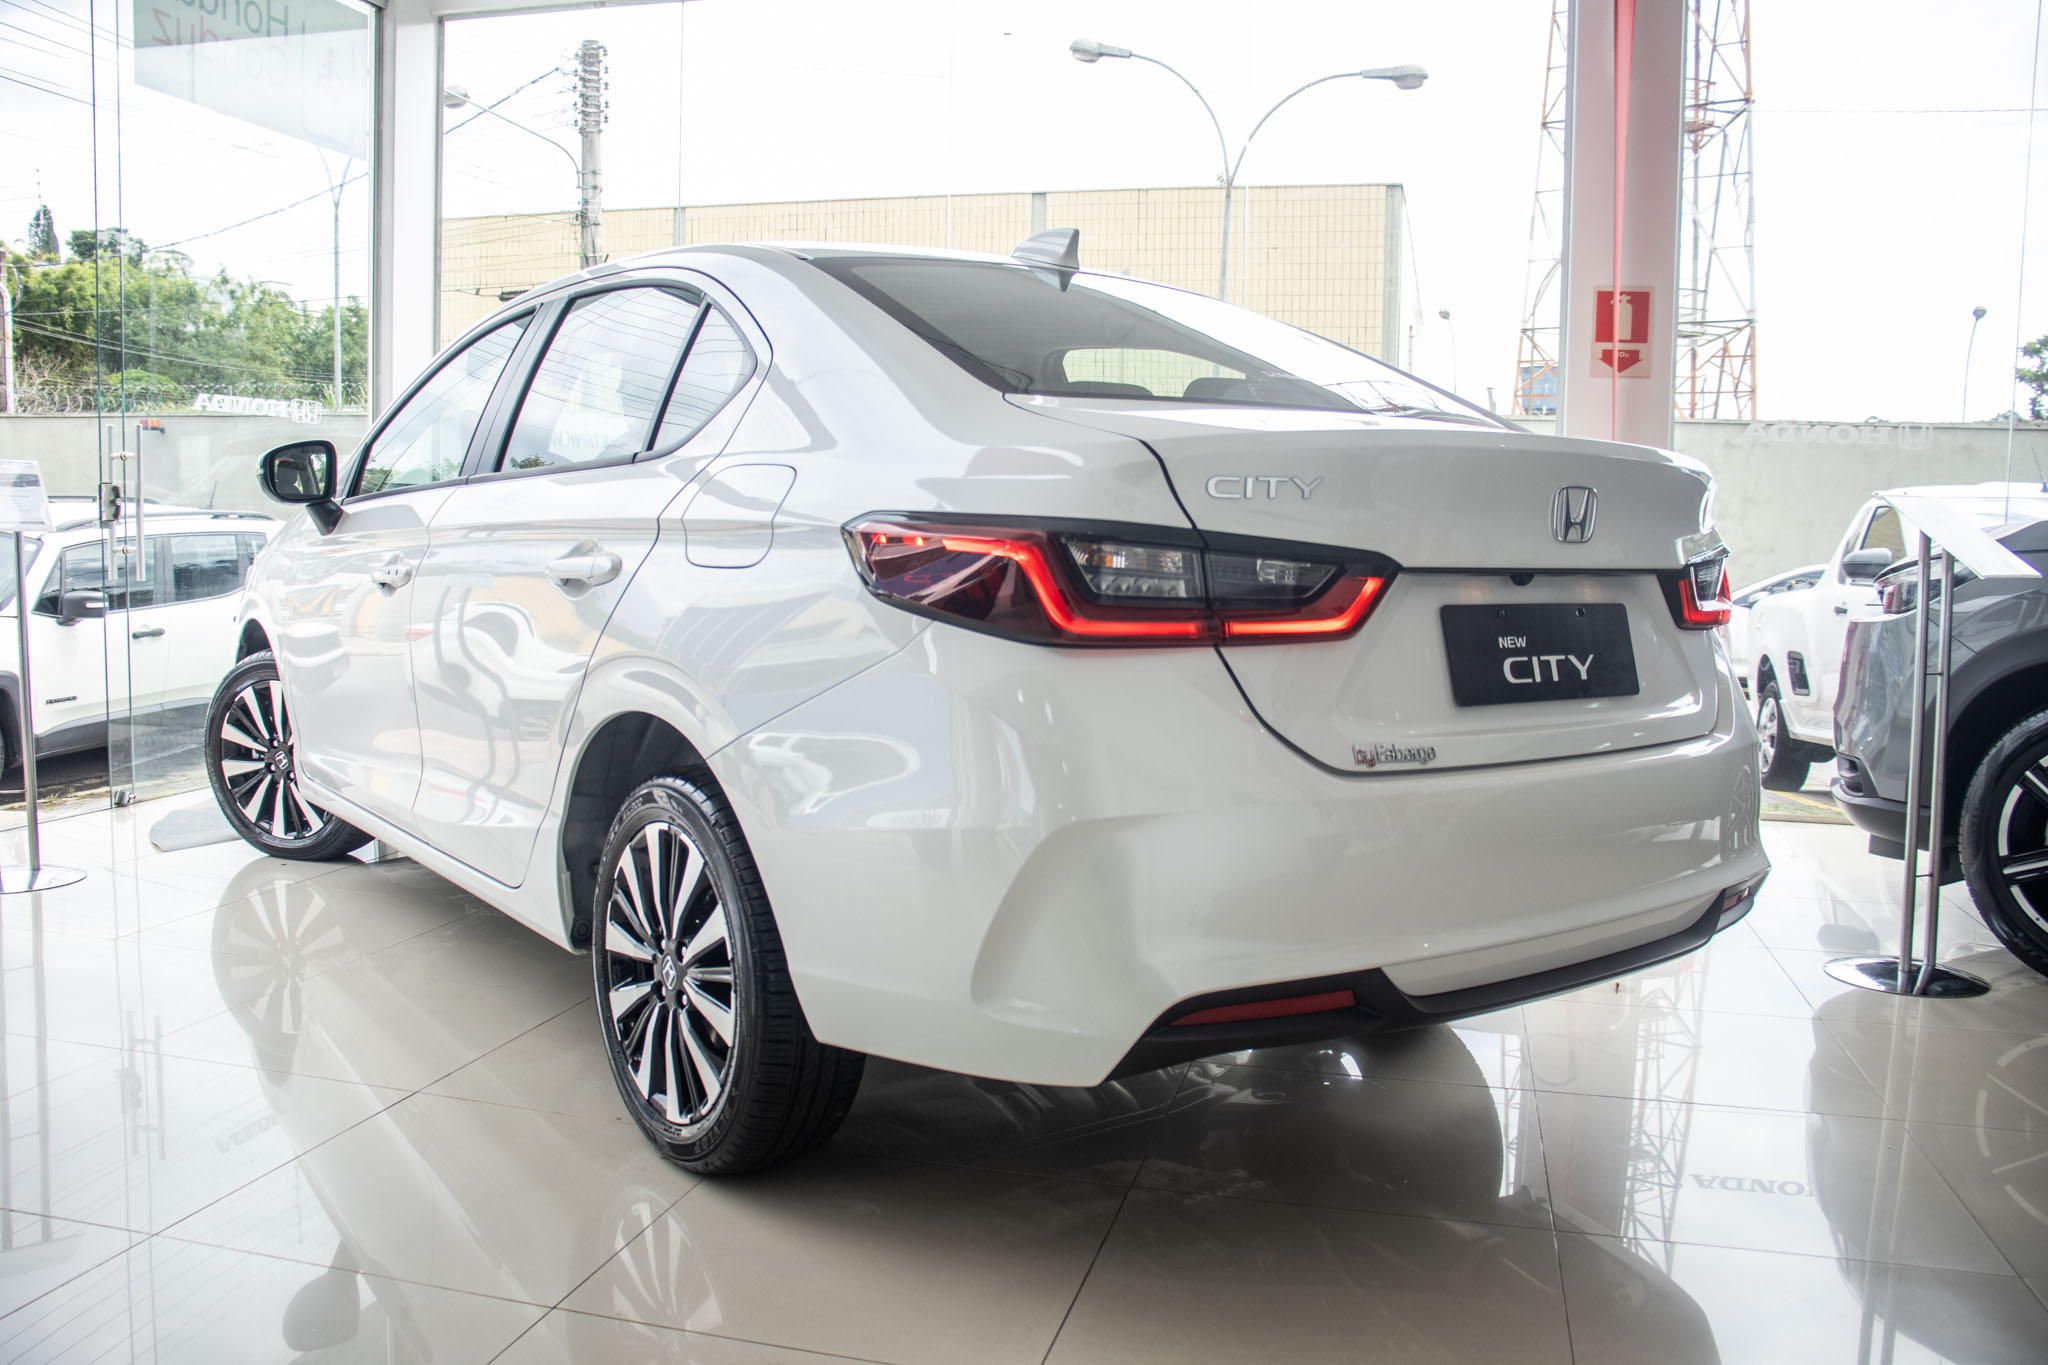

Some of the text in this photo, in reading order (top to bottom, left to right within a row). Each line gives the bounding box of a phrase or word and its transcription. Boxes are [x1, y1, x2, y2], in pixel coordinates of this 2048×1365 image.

[1204, 475, 1324, 500] CITY
[1498, 636, 1526, 648] NEW
[1503, 654, 1594, 684] CITY
